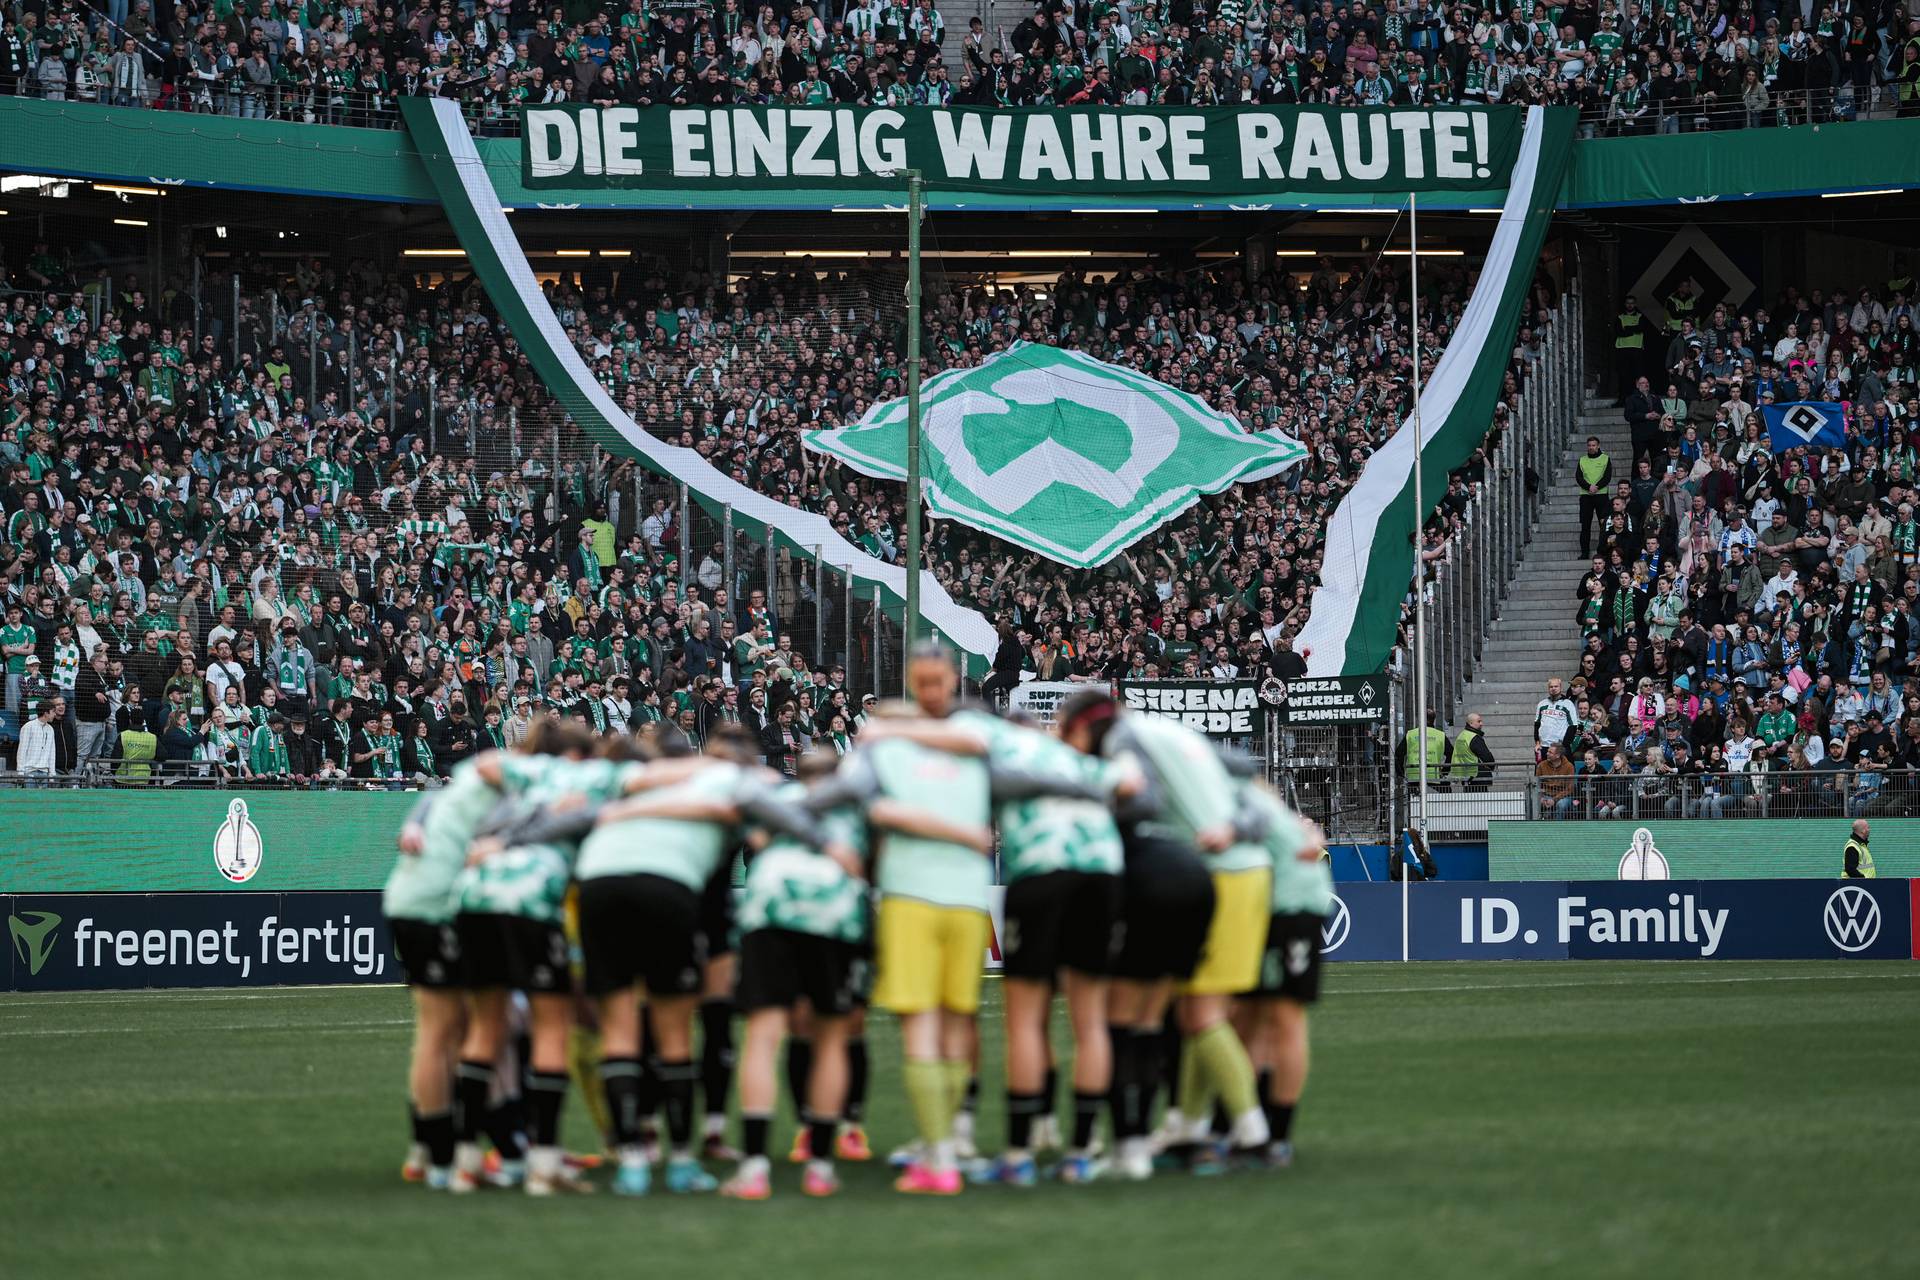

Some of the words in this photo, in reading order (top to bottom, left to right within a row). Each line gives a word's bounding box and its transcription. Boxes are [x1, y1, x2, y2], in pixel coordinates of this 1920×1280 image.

[526, 107, 643, 178] DIE
[669, 108, 907, 178] EINZIG
[932, 110, 1211, 181] WAHRE
[1237, 111, 1491, 180] RAUTE!
[1287, 680, 1342, 693] FORZA
[1287, 694, 1356, 708] WERDER
[74, 917, 251, 978] freenet,
[259, 915, 385, 975] fertig,
[1461, 897, 1539, 943] ID.
[1558, 892, 1730, 956] Family
